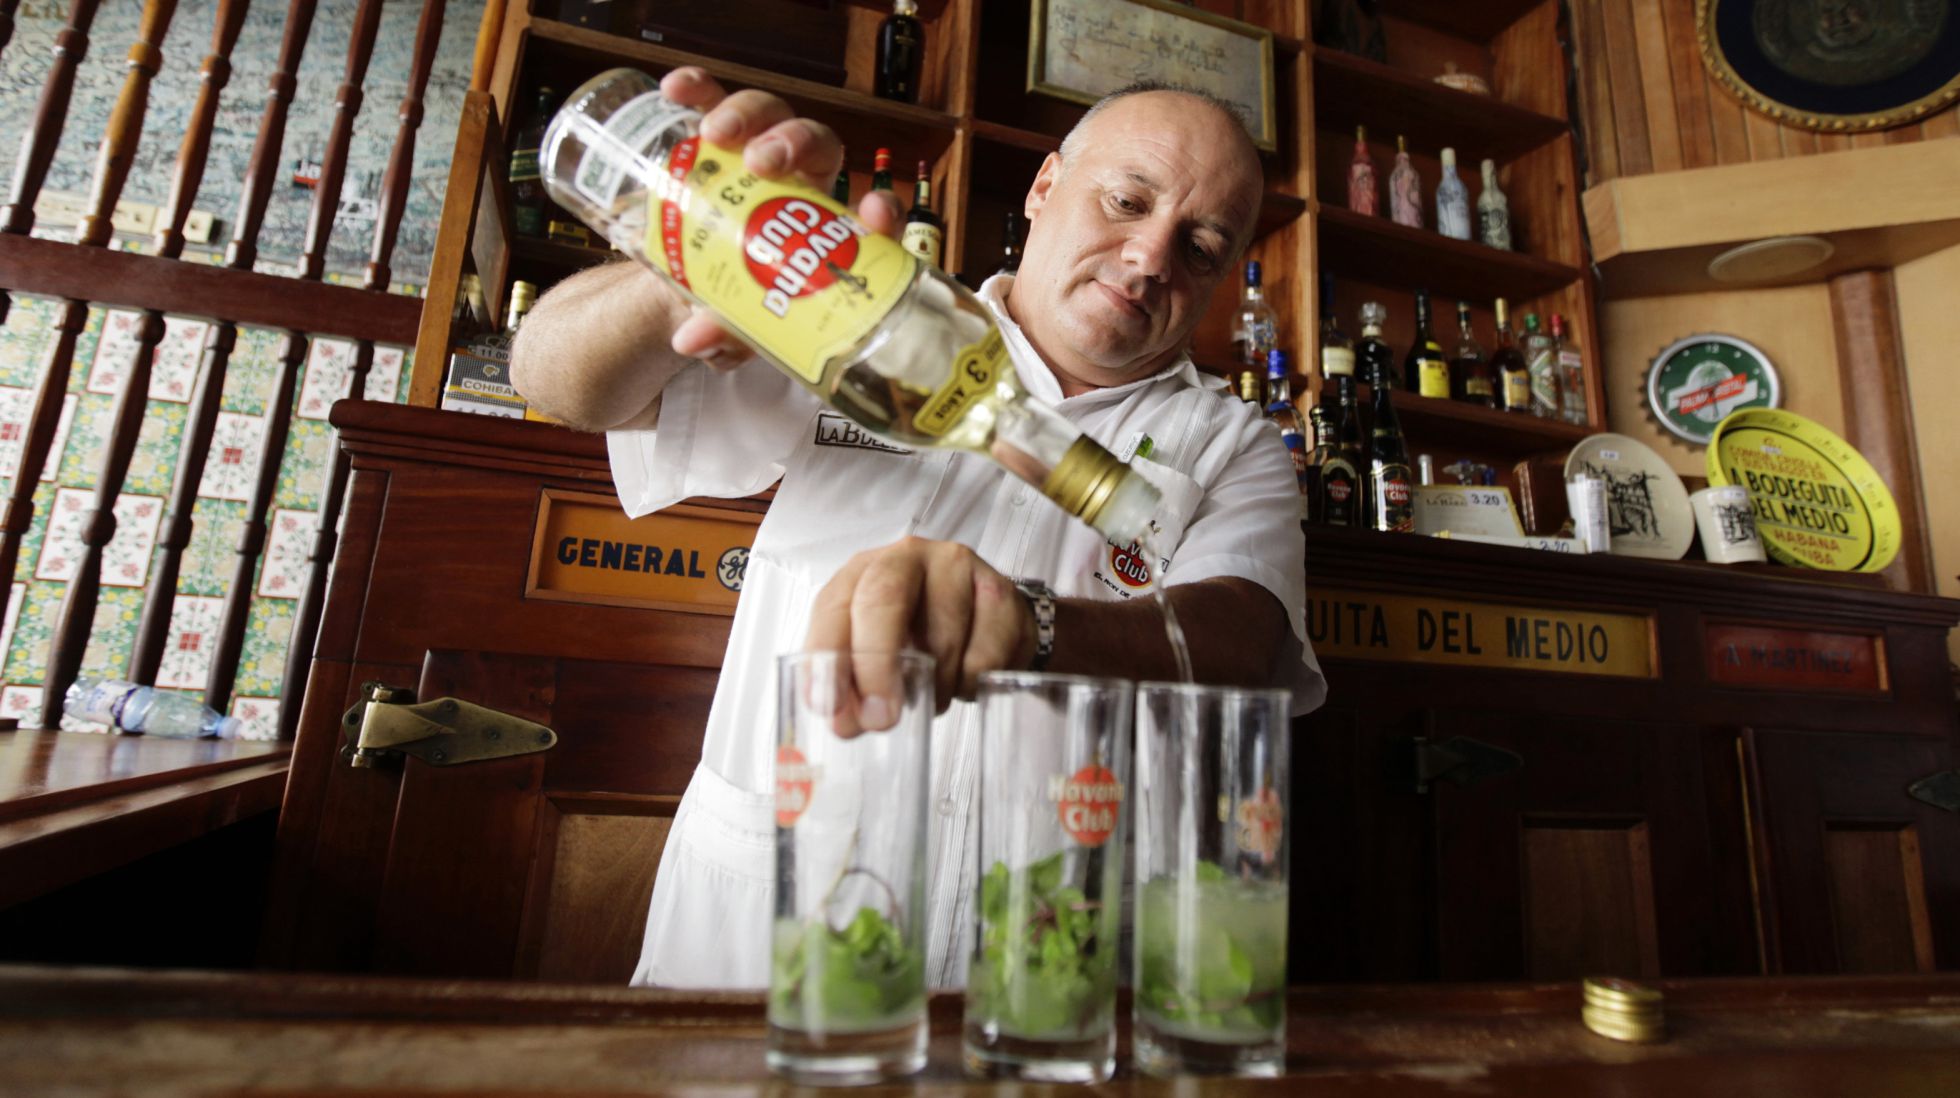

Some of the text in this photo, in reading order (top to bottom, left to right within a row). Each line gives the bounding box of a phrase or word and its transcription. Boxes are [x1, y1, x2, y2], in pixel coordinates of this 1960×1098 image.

[721, 186, 744, 205] 3
[746, 200, 821, 265] Club
[761, 214, 873, 319] Havana
[966, 359, 989, 384] 3
[463, 380, 513, 396] COHIBA
[1471, 493, 1500, 506] 3.20
[1745, 470, 1855, 512] BODEGUITA
[1782, 503, 1849, 534] MEDIO
[1774, 528, 1841, 551] HABANA
[557, 536, 706, 579] GENERAL
[1114, 555, 1149, 583] Club
[1416, 608, 1482, 655] DEL
[1505, 616, 1608, 664] MEDIO
[1064, 806, 1114, 832] Club
